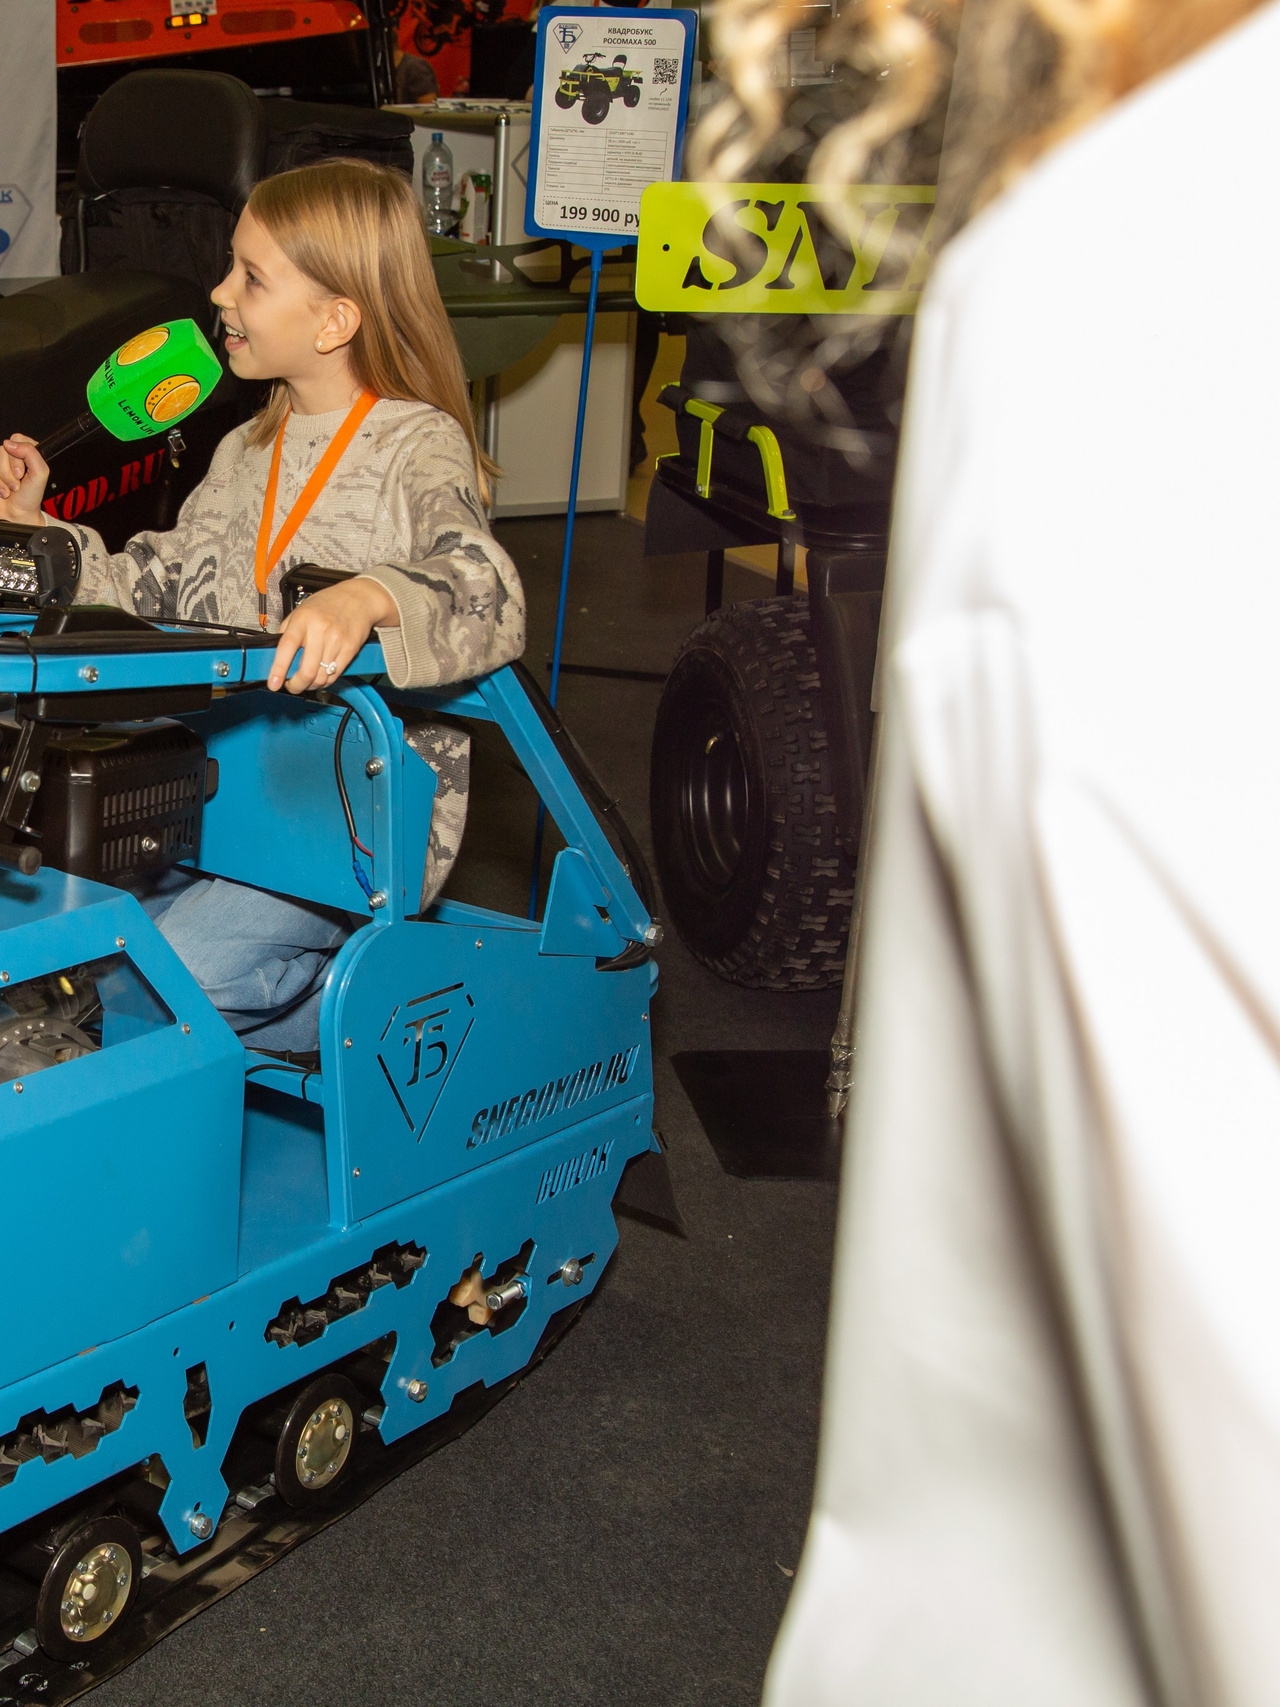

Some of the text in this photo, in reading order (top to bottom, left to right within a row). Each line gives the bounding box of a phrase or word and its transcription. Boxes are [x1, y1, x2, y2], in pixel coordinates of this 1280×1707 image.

[607, 27, 653, 36] КВАДРОБУКС
[603, 37, 657, 46] РОСОМАХА 500
[560, 205, 587, 220] 199
[592, 208, 620, 223] 900
